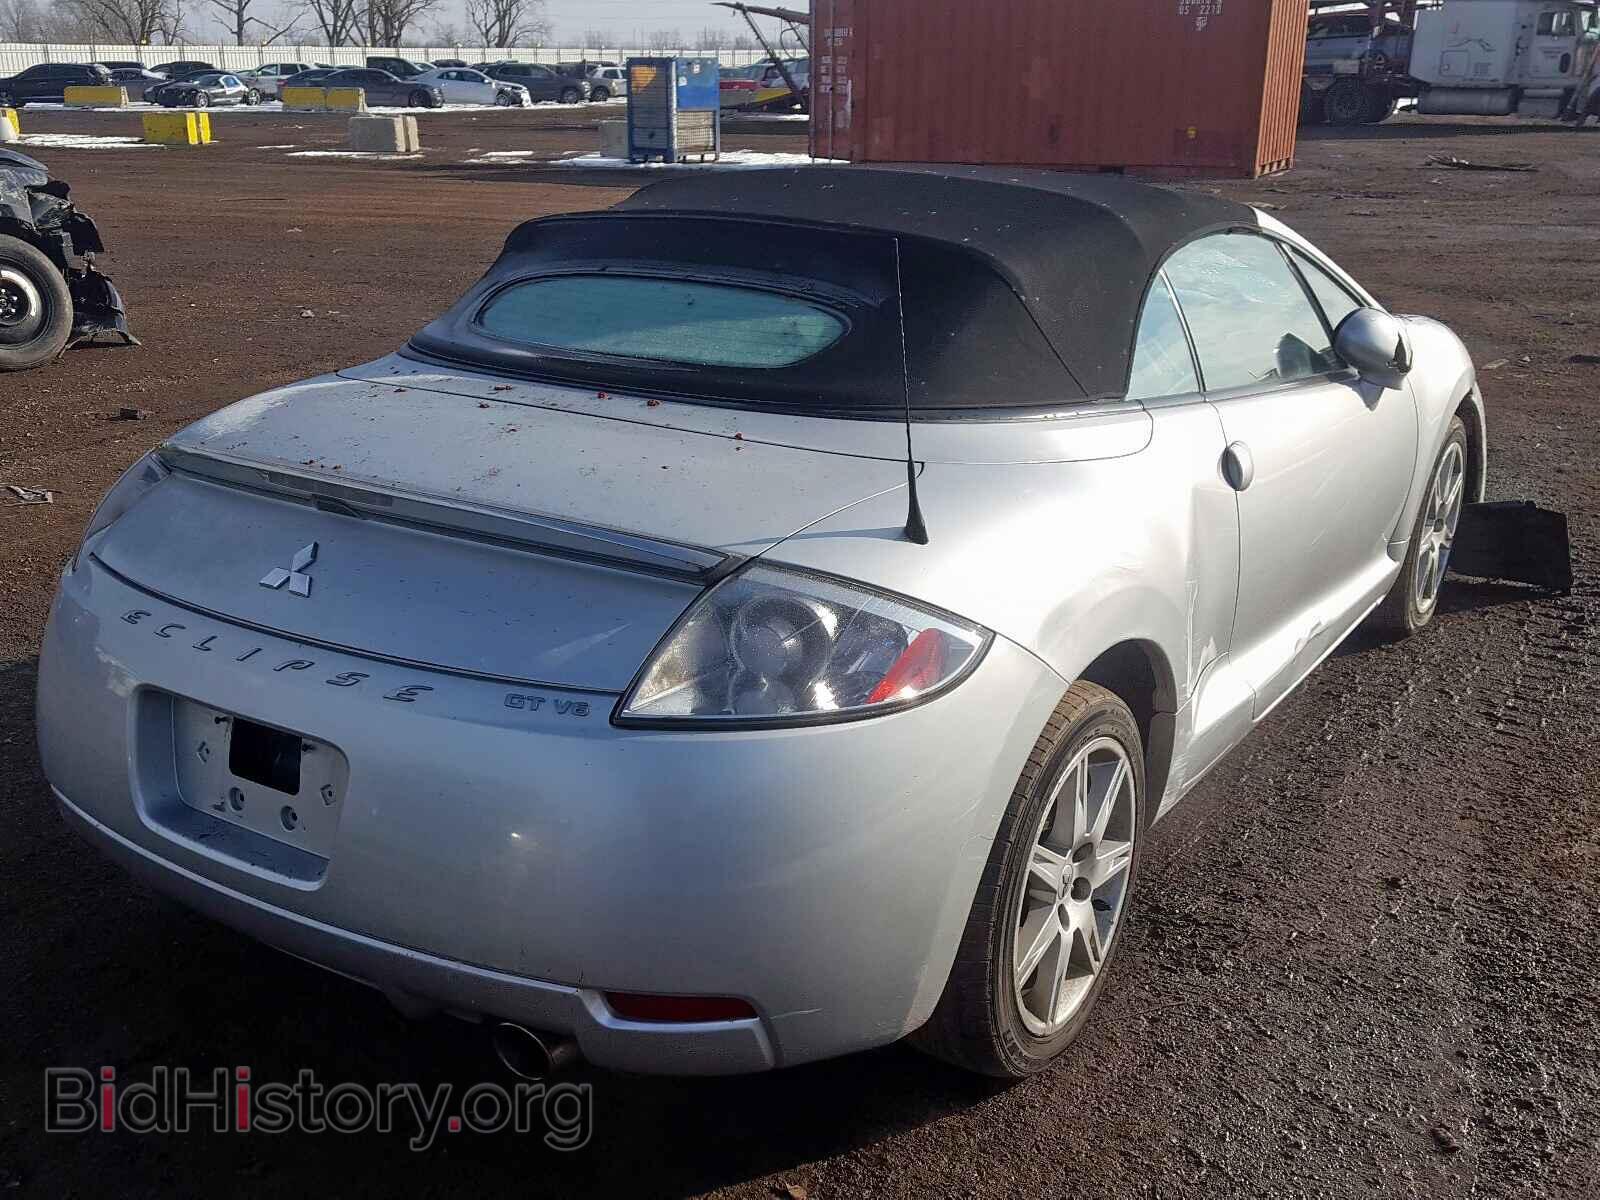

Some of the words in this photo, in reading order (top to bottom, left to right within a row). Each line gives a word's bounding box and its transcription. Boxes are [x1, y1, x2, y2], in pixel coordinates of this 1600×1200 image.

[121, 609, 434, 703] ECLIPSE
[503, 693, 545, 712] GT
[553, 699, 590, 717] V6
